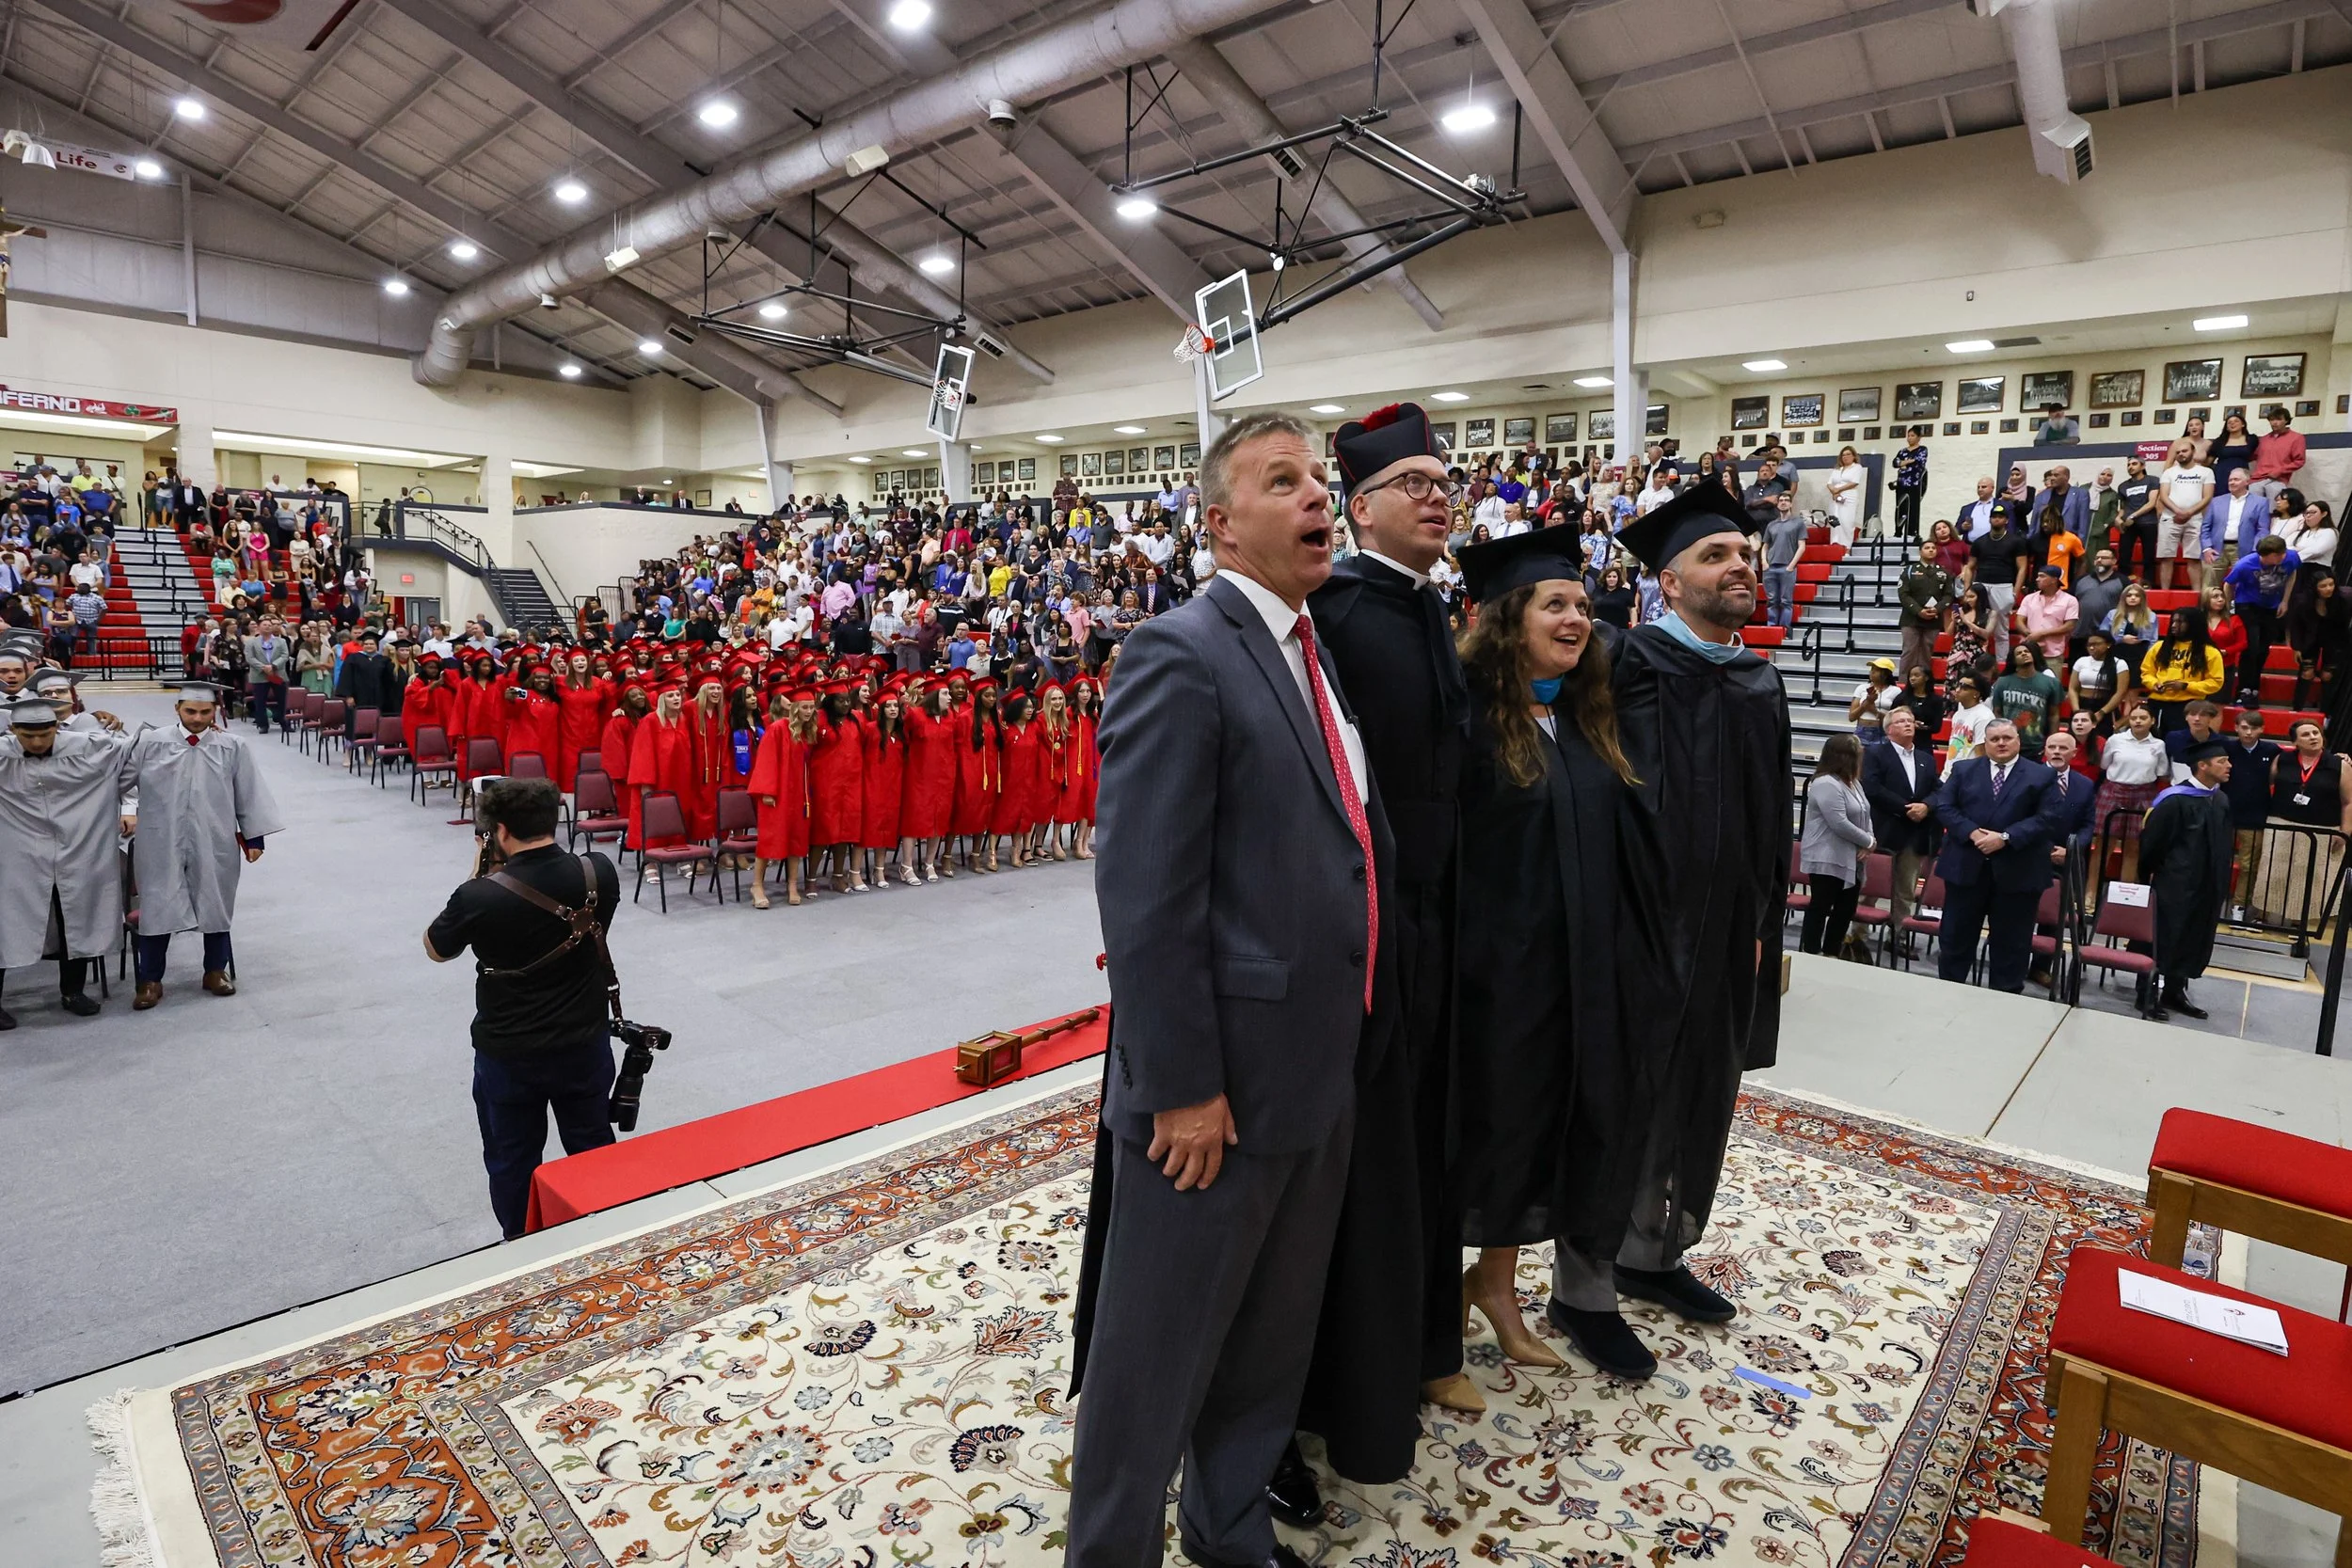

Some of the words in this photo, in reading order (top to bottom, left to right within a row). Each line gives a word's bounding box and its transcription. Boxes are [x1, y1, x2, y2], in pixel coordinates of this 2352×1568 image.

[56, 150, 98, 169] Life
[0, 390, 81, 413] FERNO
[2144, 452, 2159, 461] 305
